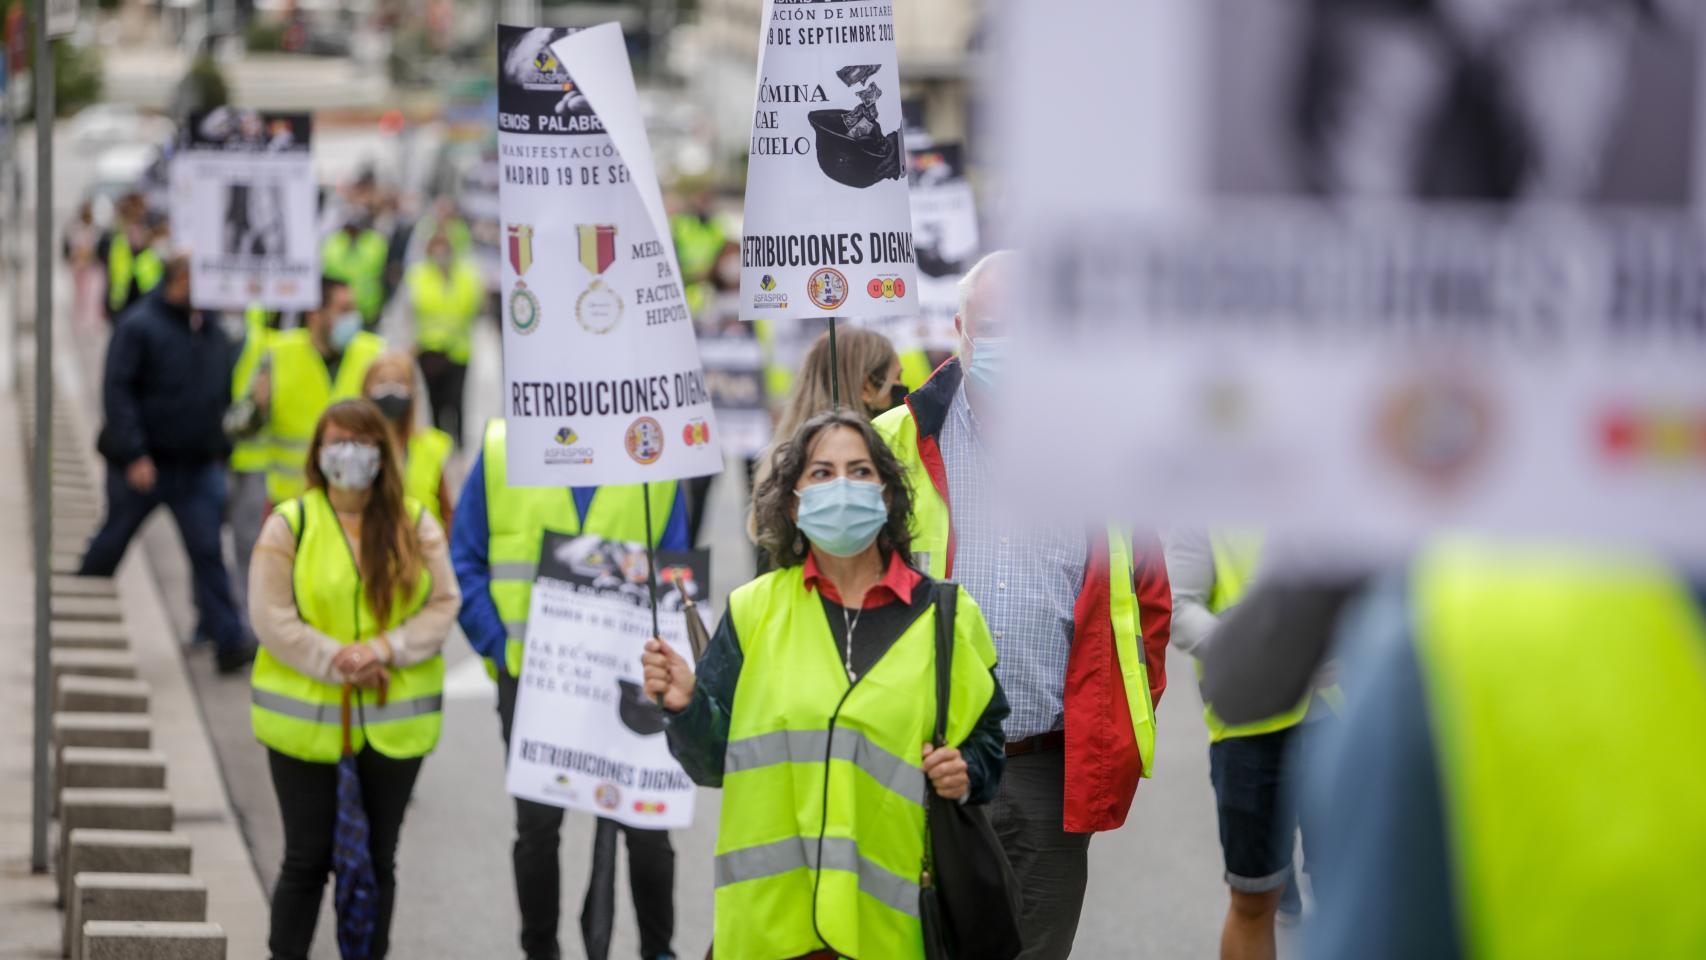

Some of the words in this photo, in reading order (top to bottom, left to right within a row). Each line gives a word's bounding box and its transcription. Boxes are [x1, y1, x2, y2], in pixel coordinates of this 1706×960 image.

[824, 9, 844, 19] DE
[777, 28, 791, 45] DE
[798, 25, 877, 45] SEPTIEMBRE
[758, 77, 830, 103] ÓMINA
[538, 115, 604, 131] PALABR
[755, 110, 779, 129] CAE
[502, 143, 621, 159] MANIFESTACIÓ
[758, 136, 811, 155] CIELO
[505, 165, 549, 186] MADRID
[557, 167, 573, 186] 19
[581, 166, 600, 185] DE
[743, 232, 863, 267] RETRIBUCIONES
[512, 374, 670, 417] RETRIBUCIONES
